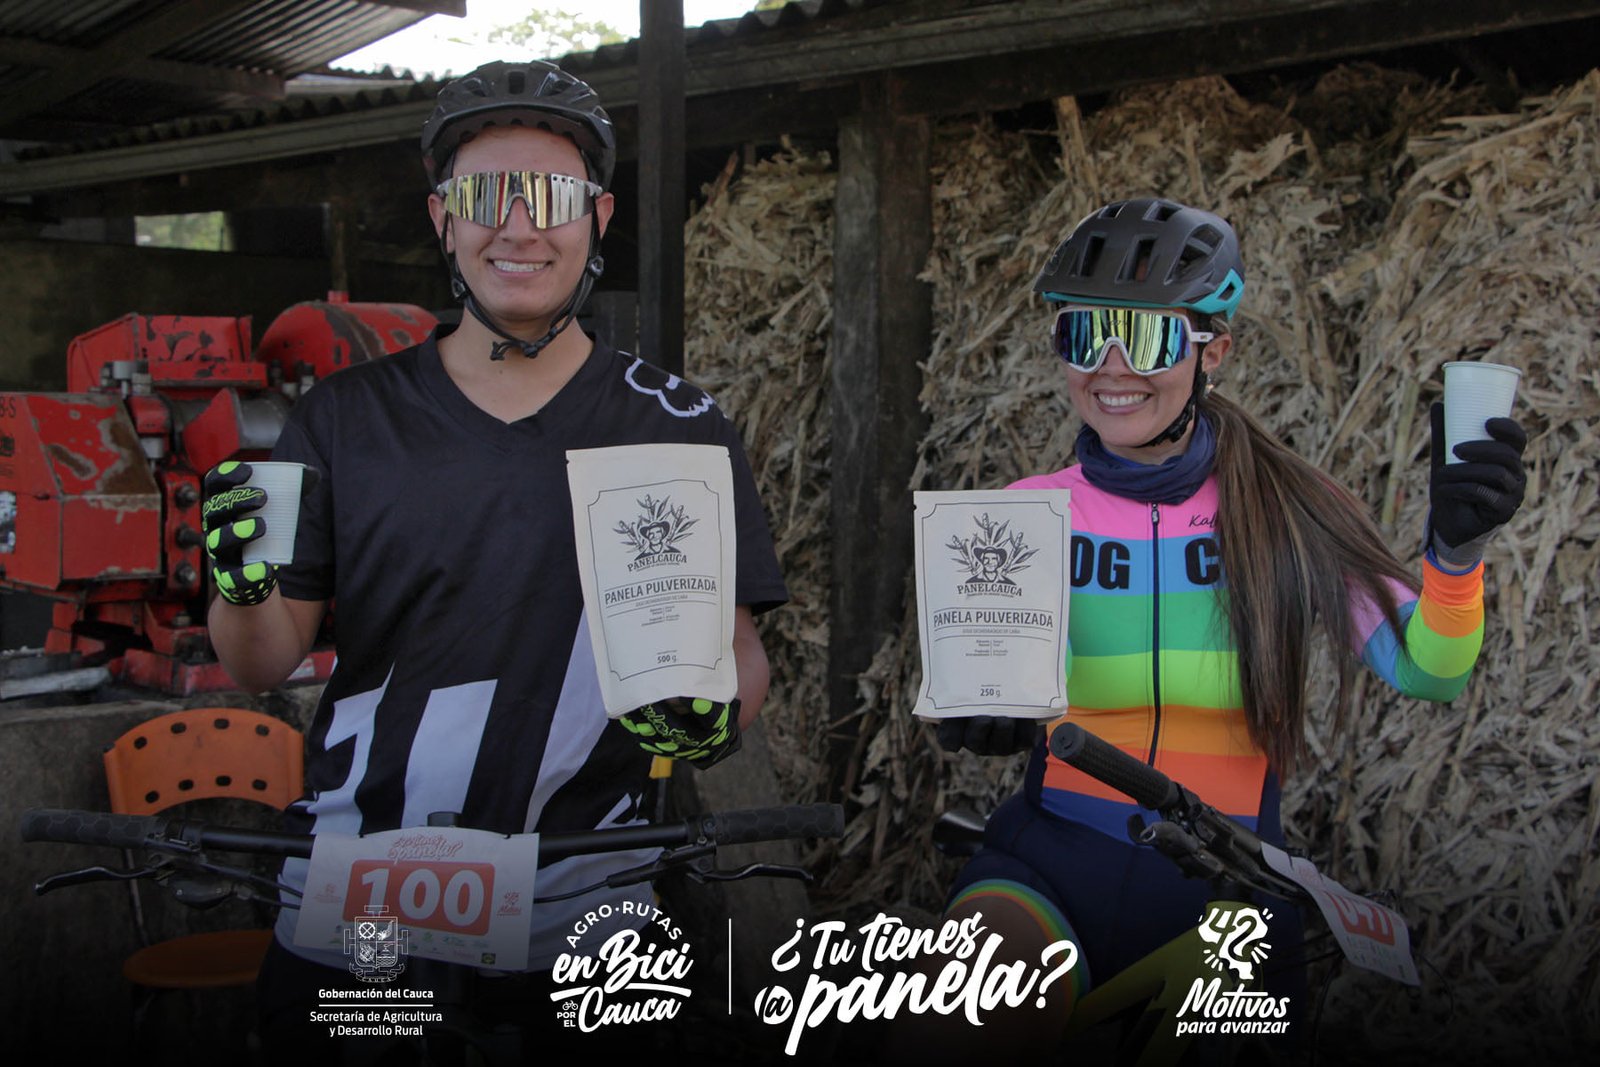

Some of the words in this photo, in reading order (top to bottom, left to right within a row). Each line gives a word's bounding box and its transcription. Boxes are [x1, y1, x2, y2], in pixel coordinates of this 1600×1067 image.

[627, 553, 687, 572] PANELCAUCA
[604, 584, 644, 605] PANELA
[645, 577, 718, 595] PULVERIZADA
[956, 583, 1023, 597] PANELCAUCA
[933, 611, 973, 628] PANELA
[975, 611, 1054, 628] PULVERIZADA
[657, 655, 671, 664] 500
[980, 688, 995, 697] 250
[361, 867, 485, 927] 100
